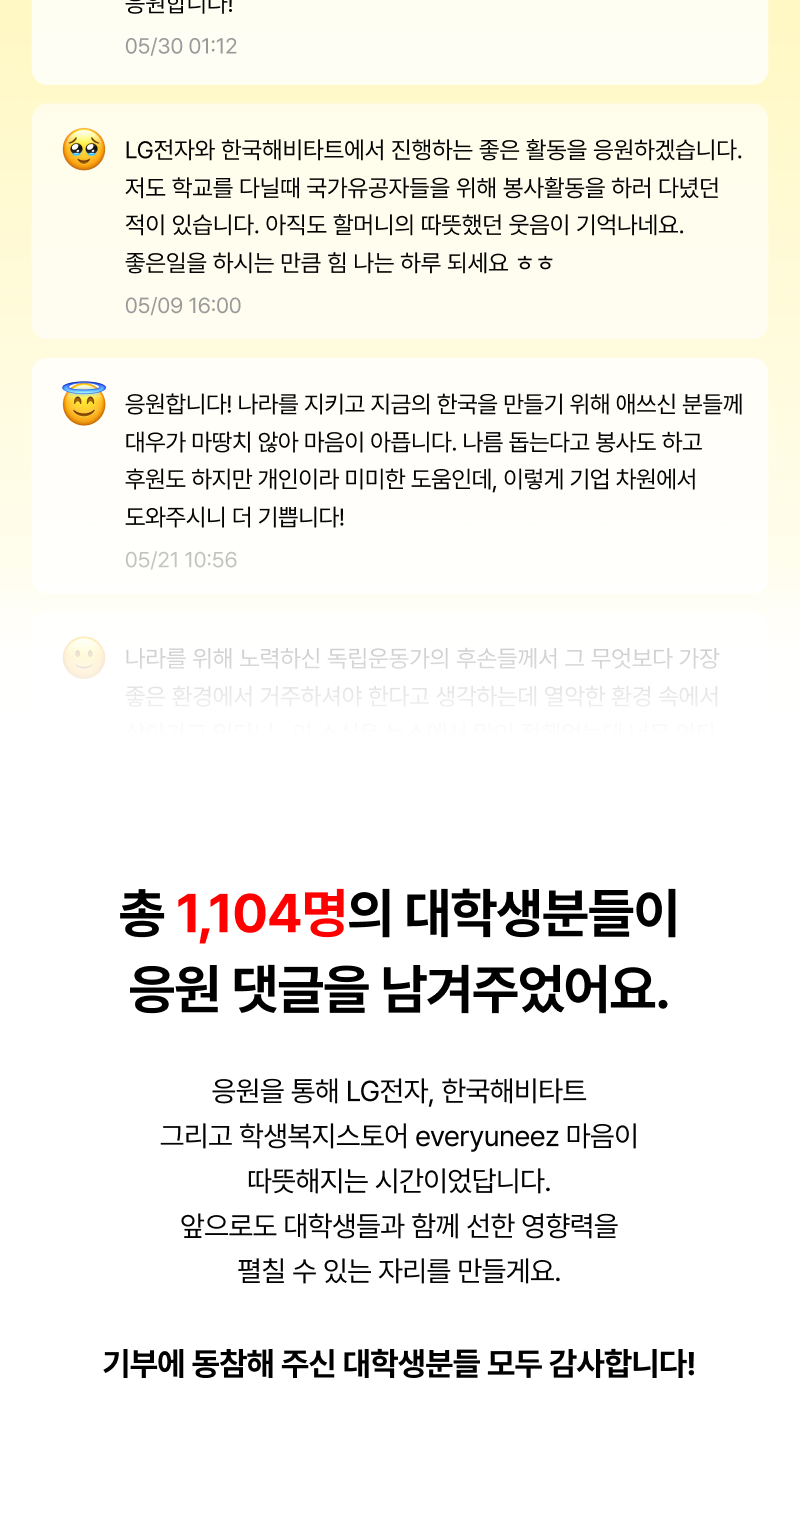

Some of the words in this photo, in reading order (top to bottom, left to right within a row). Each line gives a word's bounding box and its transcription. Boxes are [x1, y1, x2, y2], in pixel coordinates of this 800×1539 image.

[126, 37, 182, 56] 05/30
[189, 38, 237, 54] 01:12
[126, 139, 215, 160] LG전자와
[222, 139, 383, 160] 한국해비타트에서
[392, 139, 473, 160] 진행하는
[479, 140, 519, 161] 좋은
[526, 139, 587, 160] 활동을
[594, 139, 741, 160] 응원하겠습니다.
[125, 506, 224, 528] 도와주시니
[234, 506, 250, 528] 더
[259, 506, 344, 528] 기쁩니다!
[126, 551, 177, 570] 05/21
[185, 552, 237, 568] 10:56
[126, 648, 186, 669] 나라를
[193, 648, 232, 669] 위해
[240, 648, 319, 669] 노력하신
[328, 648, 448, 669] 독립운동가의
[457, 648, 556, 669] 후손들께서
[565, 650, 584, 666] 그
[591, 648, 673, 669] 무엇보다
[680, 648, 719, 669] 가장
[120, 889, 164, 937] 총
[178, 889, 390, 944] 1,104명의
[407, 888, 676, 937] 대학생분들이
[130, 965, 218, 1013] 응원
[235, 965, 369, 1013] 댓글을
[384, 965, 668, 1013] 남겨주었어요.
[212, 1078, 284, 1104] 응원을
[292, 1078, 337, 1104] 통해
[348, 1078, 433, 1107] LG전자,
[442, 1078, 586, 1104] 한국해비타트
[249, 1168, 368, 1194] 따뜻해지는
[376, 1168, 550, 1194] 시간이었답니다.
[104, 1349, 183, 1378] 기부에
[192, 1349, 273, 1378] 동참해
[282, 1349, 334, 1378] 주신
[344, 1349, 480, 1378] 대학생분들
[488, 1350, 542, 1378] 모두
[550, 1349, 694, 1378] 감사합니다!
